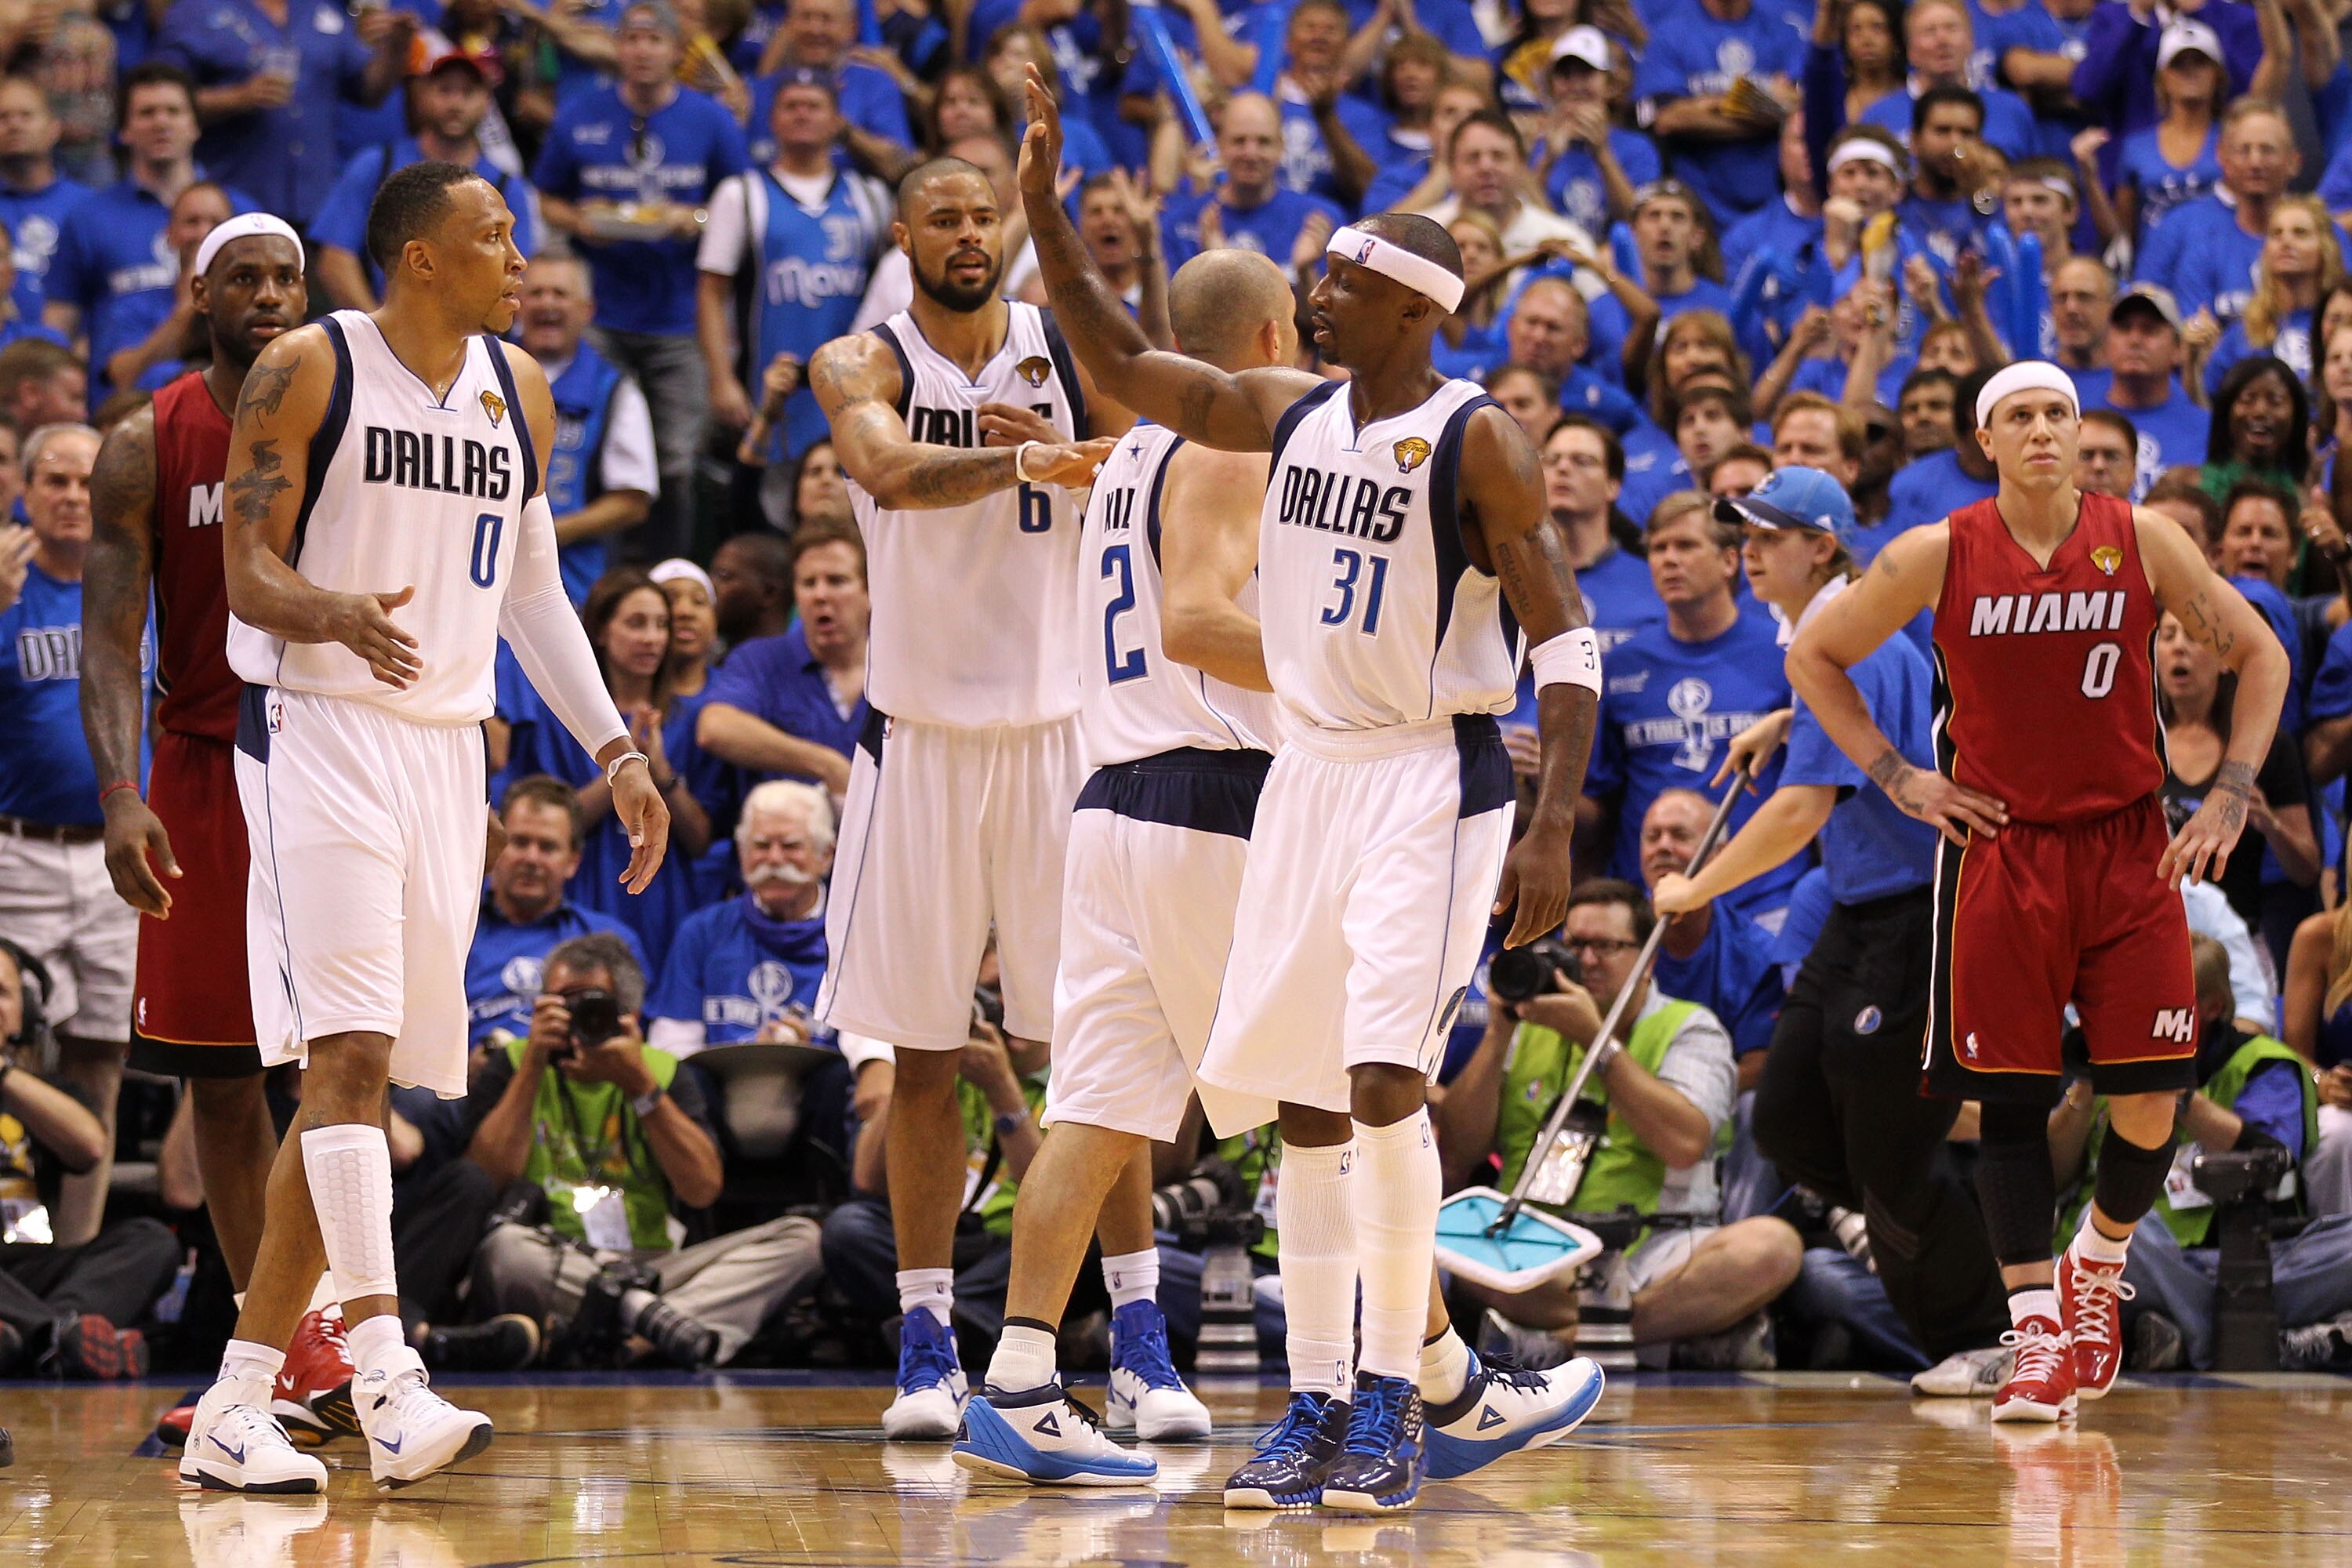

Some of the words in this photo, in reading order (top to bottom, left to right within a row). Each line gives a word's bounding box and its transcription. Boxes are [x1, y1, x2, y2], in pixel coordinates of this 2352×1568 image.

[364, 426, 510, 502] DALLAS
[1019, 482, 1052, 534] 6
[1279, 465, 1414, 544] DALLAS
[470, 514, 503, 587] 0
[1101, 544, 1149, 686] 2
[1320, 547, 1390, 636] 31
[1969, 590, 2126, 637] MIAMI
[2081, 642, 2122, 699] 0
